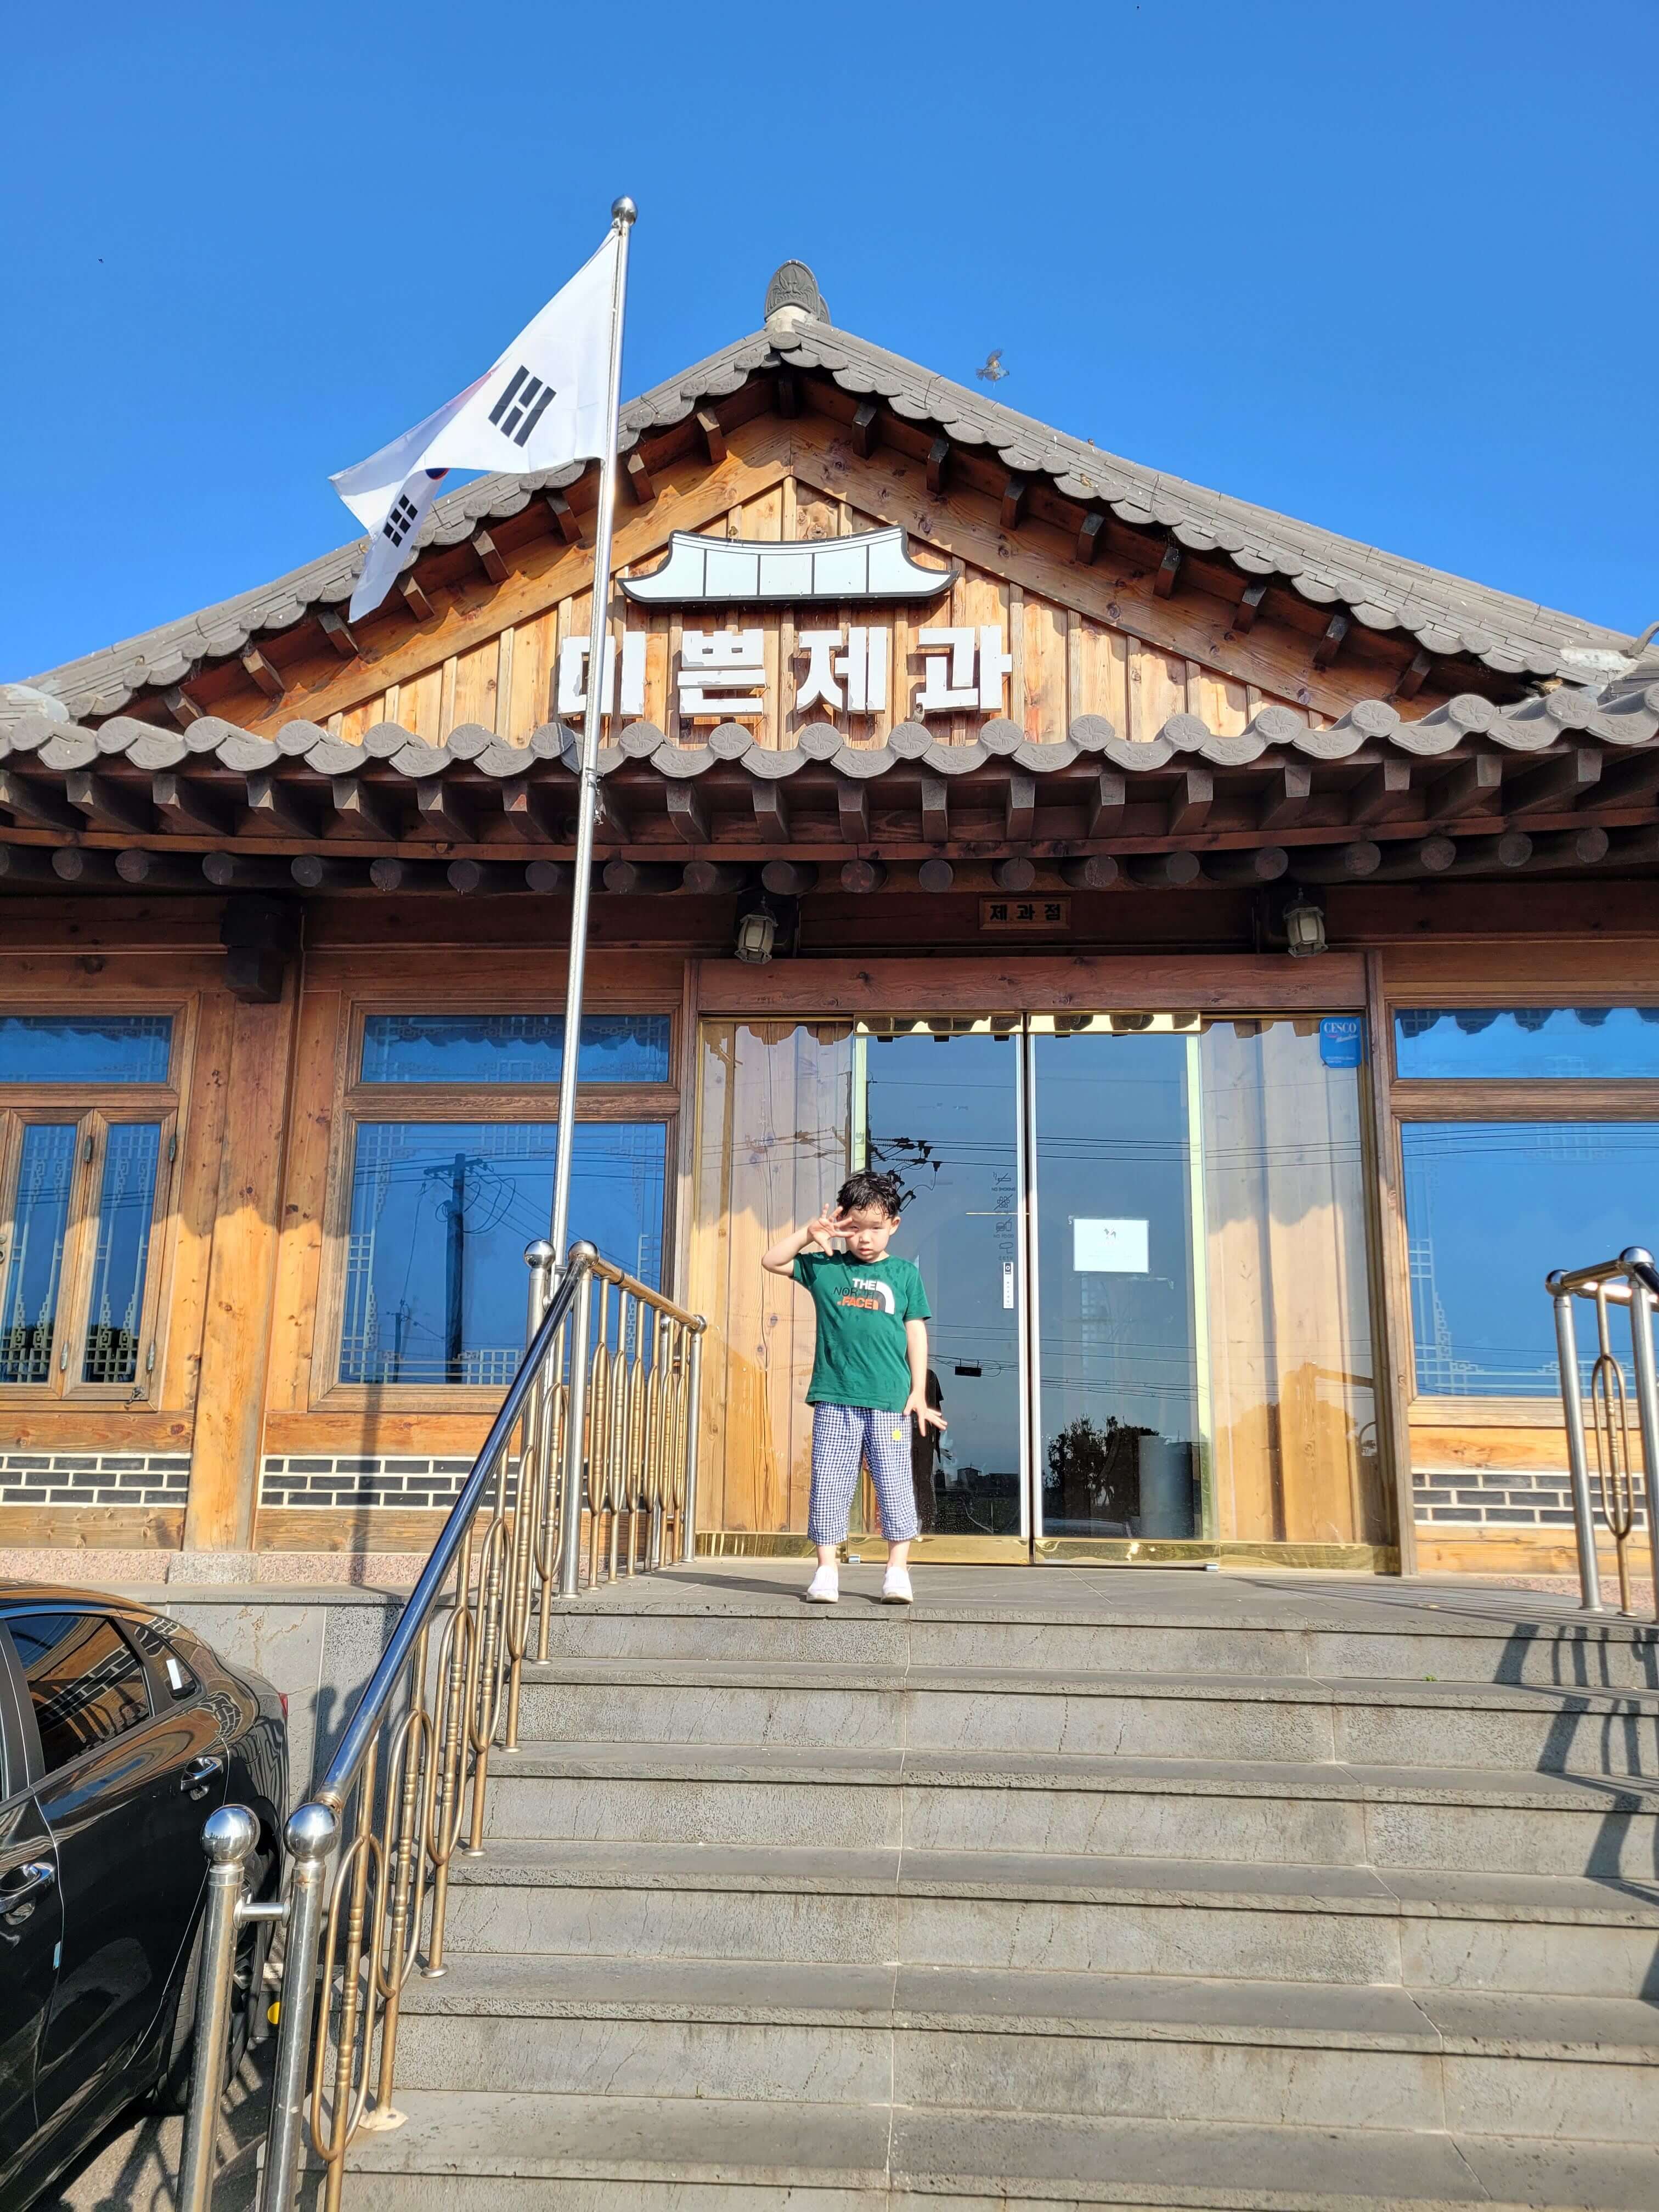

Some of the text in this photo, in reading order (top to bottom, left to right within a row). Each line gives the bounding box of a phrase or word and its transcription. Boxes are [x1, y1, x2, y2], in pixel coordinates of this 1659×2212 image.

[557, 625, 1013, 716] 미쁜제과
[989, 904, 1061, 921] 제과점
[1324, 1022, 1357, 1034] CESCO
[852, 1277, 876, 1291] THE
[833, 1286, 874, 1300] NORH
[842, 1295, 873, 1310] FACE
